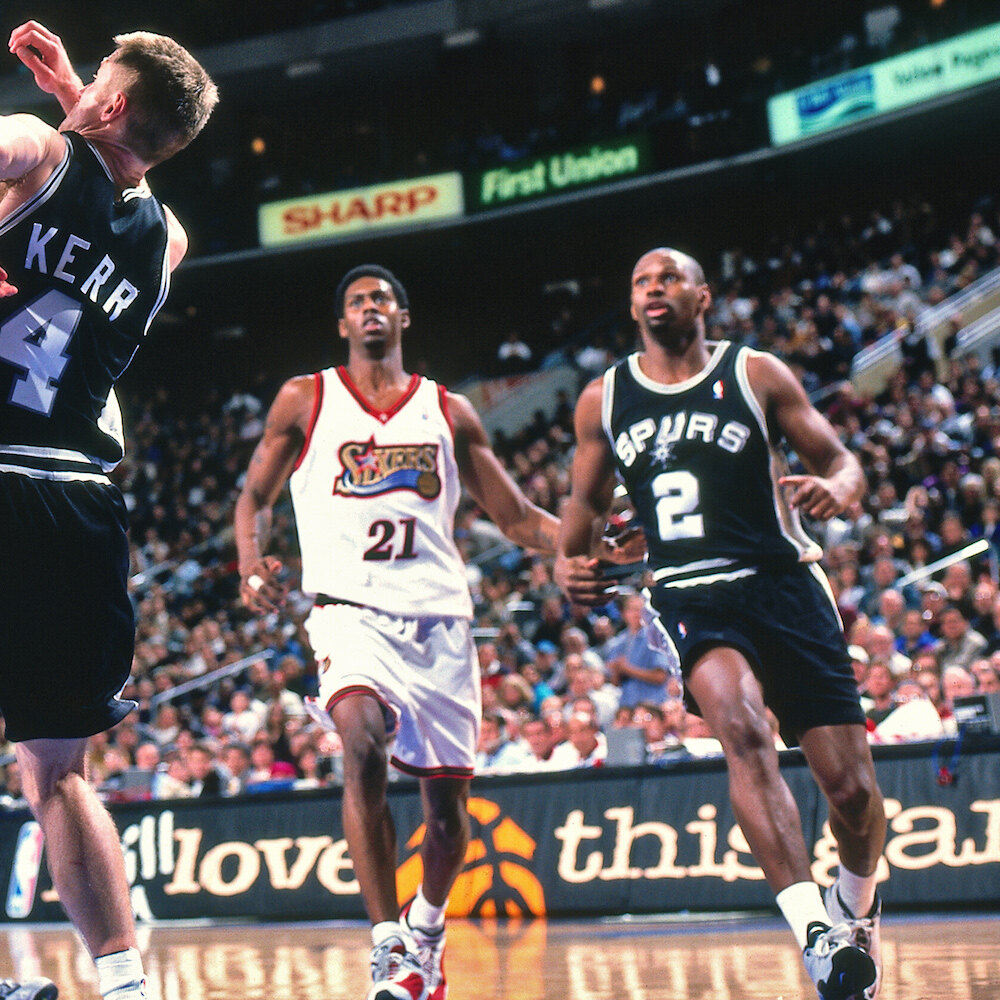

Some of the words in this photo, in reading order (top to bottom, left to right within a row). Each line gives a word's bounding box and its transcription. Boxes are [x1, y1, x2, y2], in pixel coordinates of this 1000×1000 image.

[480, 160, 547, 204] First
[550, 144, 639, 188] Union
[281, 184, 439, 236] SHARP
[24, 222, 141, 323] KERR
[615, 409, 751, 468] SPURS
[651, 470, 706, 541] 2
[362, 517, 419, 561] 21
[163, 827, 361, 897] love
